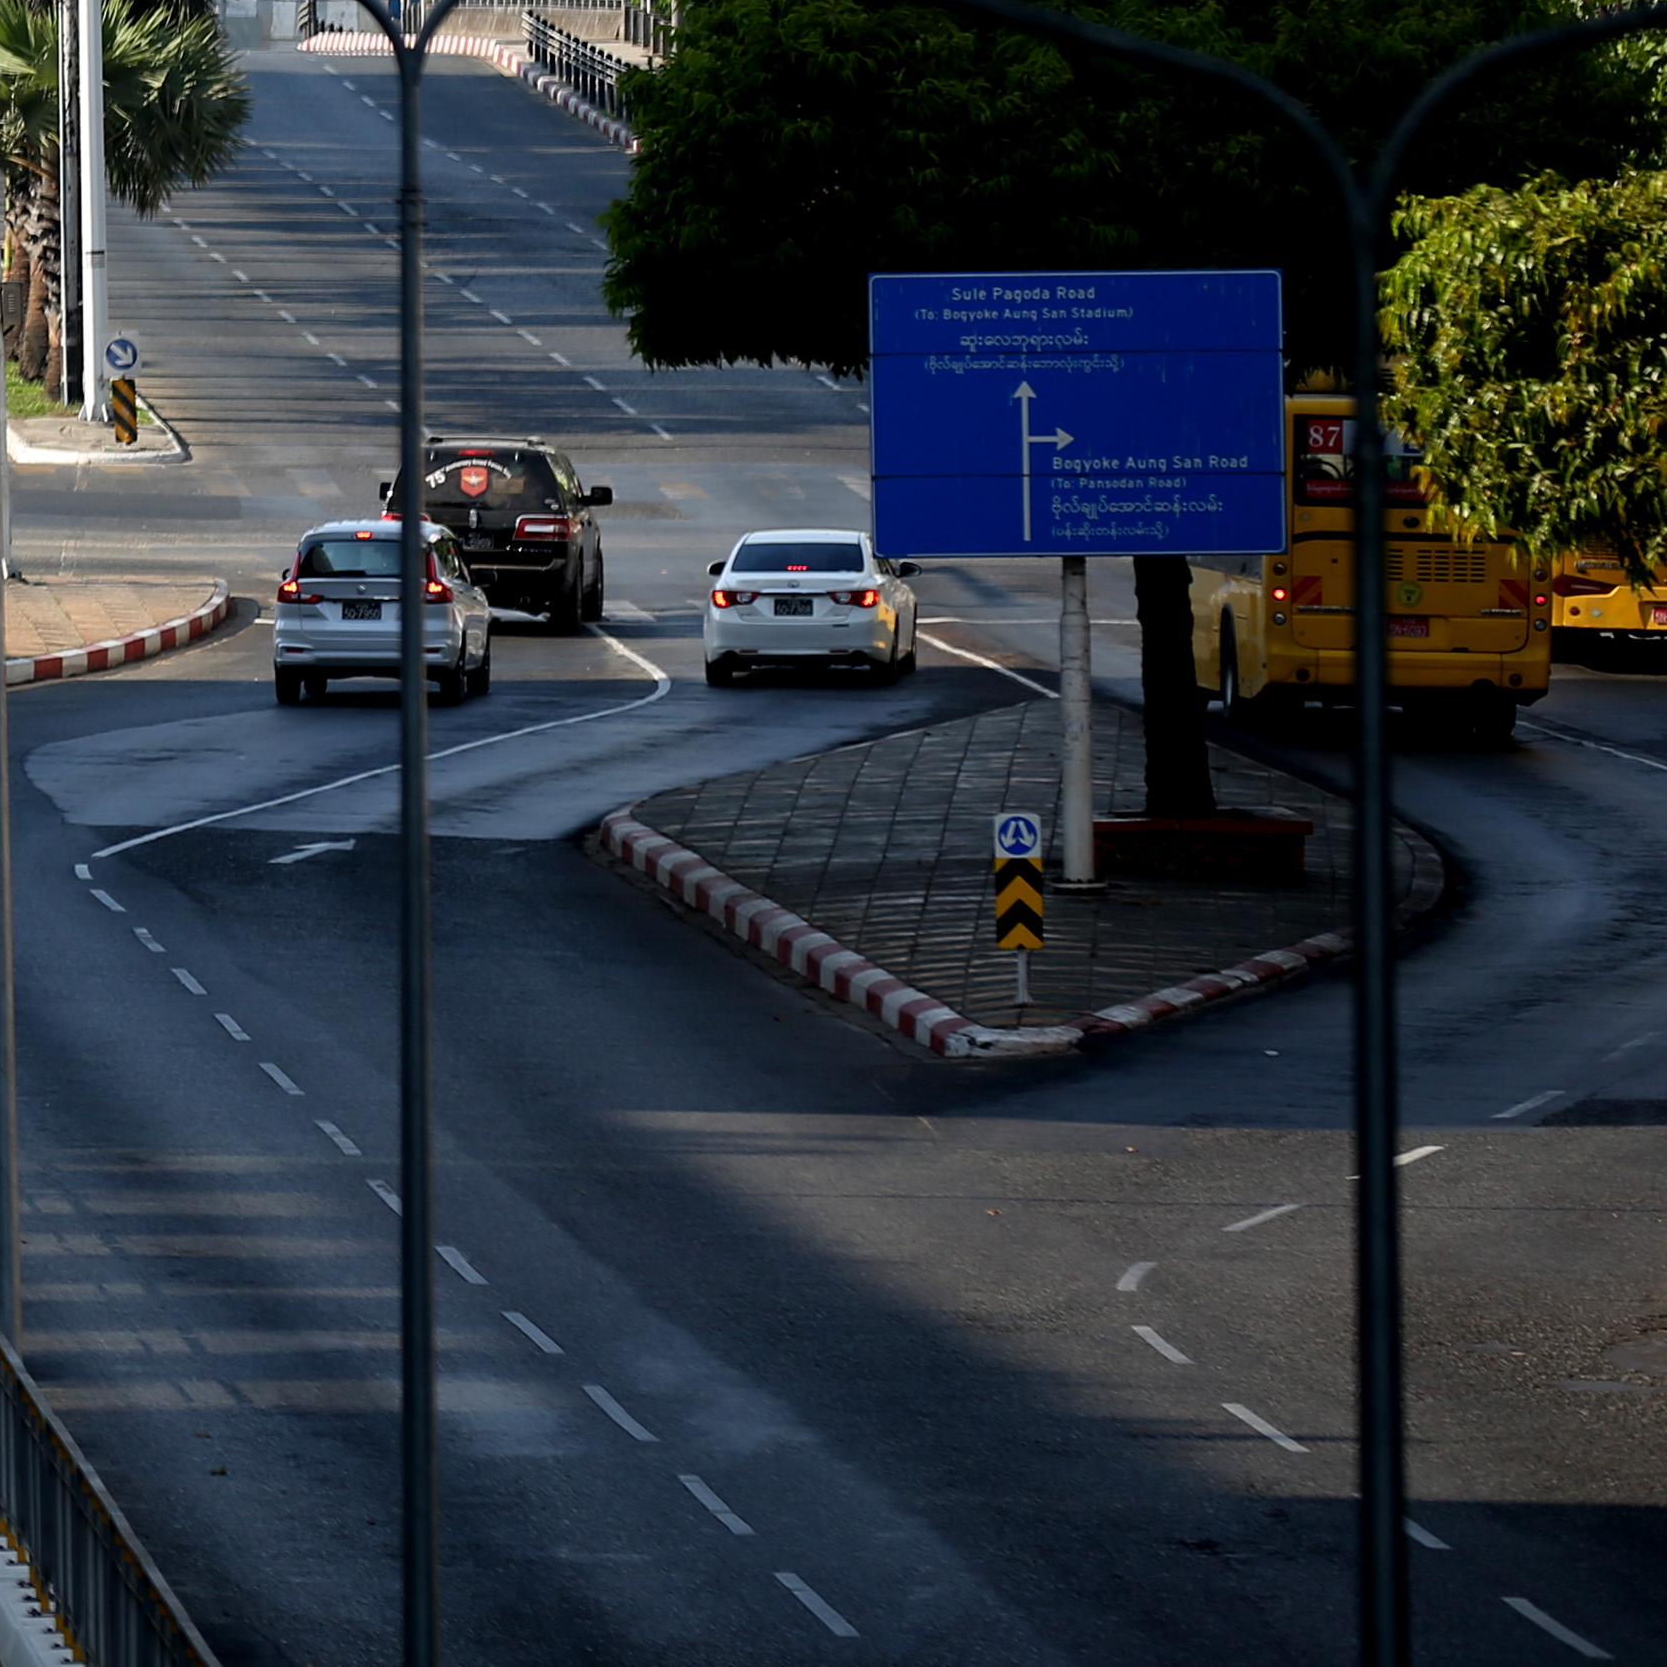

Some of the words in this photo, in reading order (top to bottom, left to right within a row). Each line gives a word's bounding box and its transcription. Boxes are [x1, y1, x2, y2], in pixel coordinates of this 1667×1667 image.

[953, 288, 986, 300] Sule
[993, 287, 1049, 303] Pagoda
[1057, 287, 1094, 298] Road
[944, 309, 998, 322] Bogyoke
[1004, 309, 1037, 320] Aung
[1043, 308, 1066, 318] San
[1072, 308, 1133, 318] Stadium)
[1308, 425, 1341, 448] 87
[1053, 457, 1119, 473] Bogyoke
[1126, 457, 1166, 471] Aung
[1174, 456, 1201, 468] San
[1210, 456, 1247, 467] Road
[1080, 478, 1143, 488] Pansodan
[1149, 477, 1186, 487] Road)
